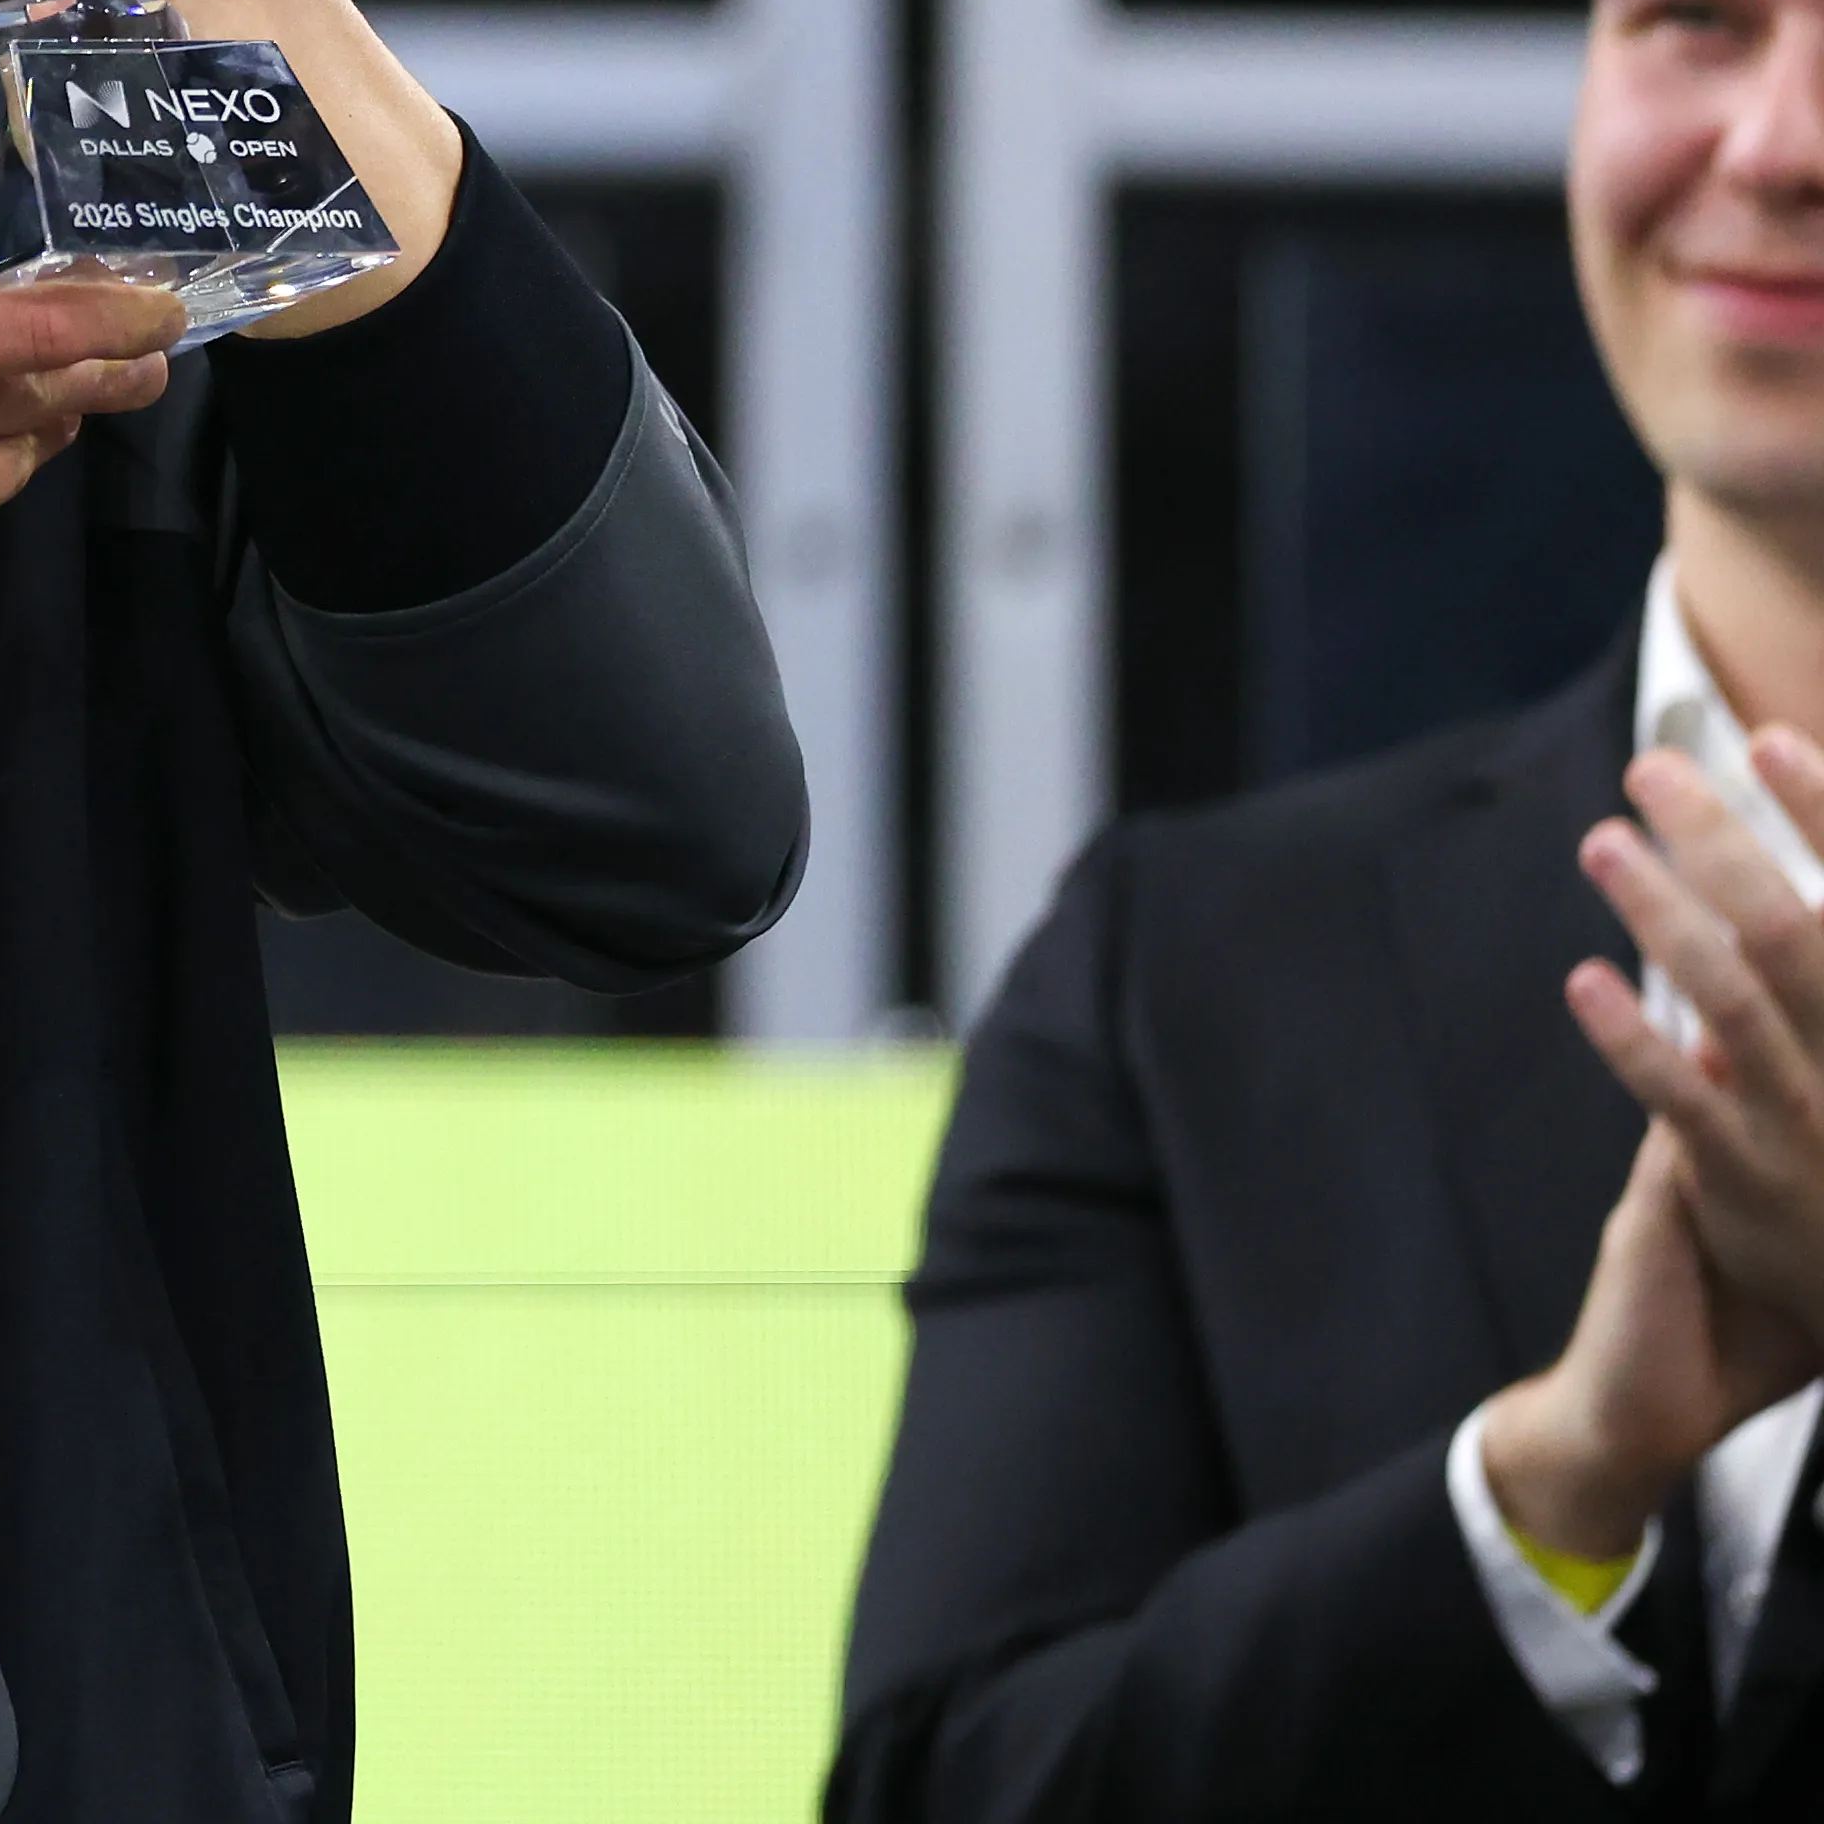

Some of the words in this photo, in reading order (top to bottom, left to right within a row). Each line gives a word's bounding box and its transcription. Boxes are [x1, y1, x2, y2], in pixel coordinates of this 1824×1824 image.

[145, 88, 281, 123] NEXO
[79, 138, 174, 156] DALLAS
[229, 139, 299, 157] OPEN
[68, 202, 133, 228] 2026
[135, 202, 230, 234] Singles
[233, 202, 364, 234] Champion
